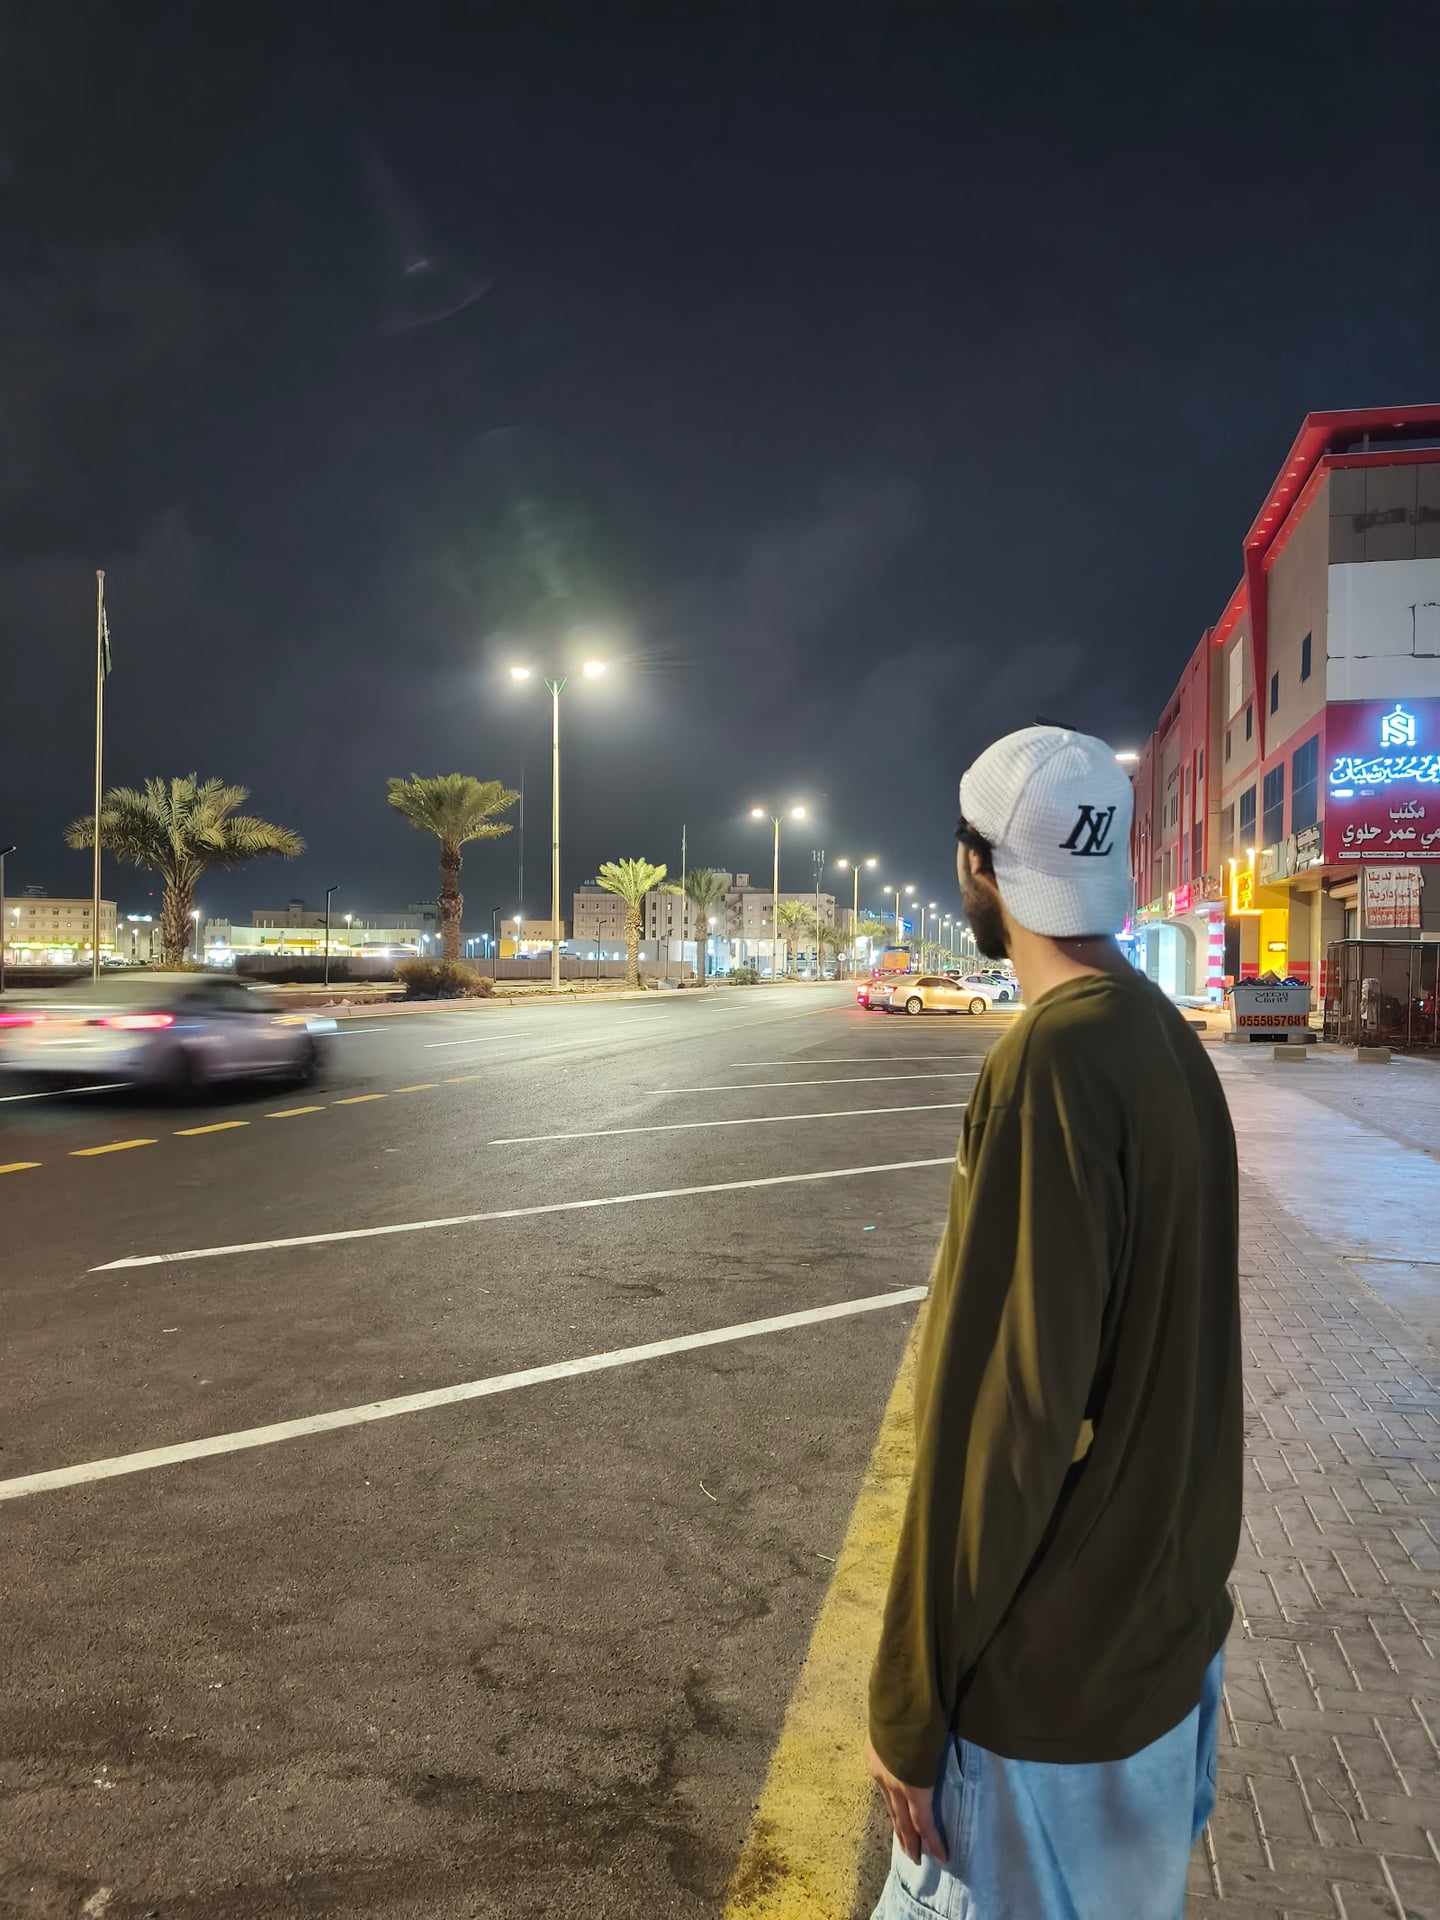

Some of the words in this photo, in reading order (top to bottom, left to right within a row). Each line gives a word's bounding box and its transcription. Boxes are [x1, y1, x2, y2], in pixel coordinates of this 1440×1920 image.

[1389, 800, 1425, 823] مكتب
[1341, 822, 1382, 847] حلوي
[1383, 827, 1417, 844] عمر
[1239, 1015, 1307, 1027] 0555857681
